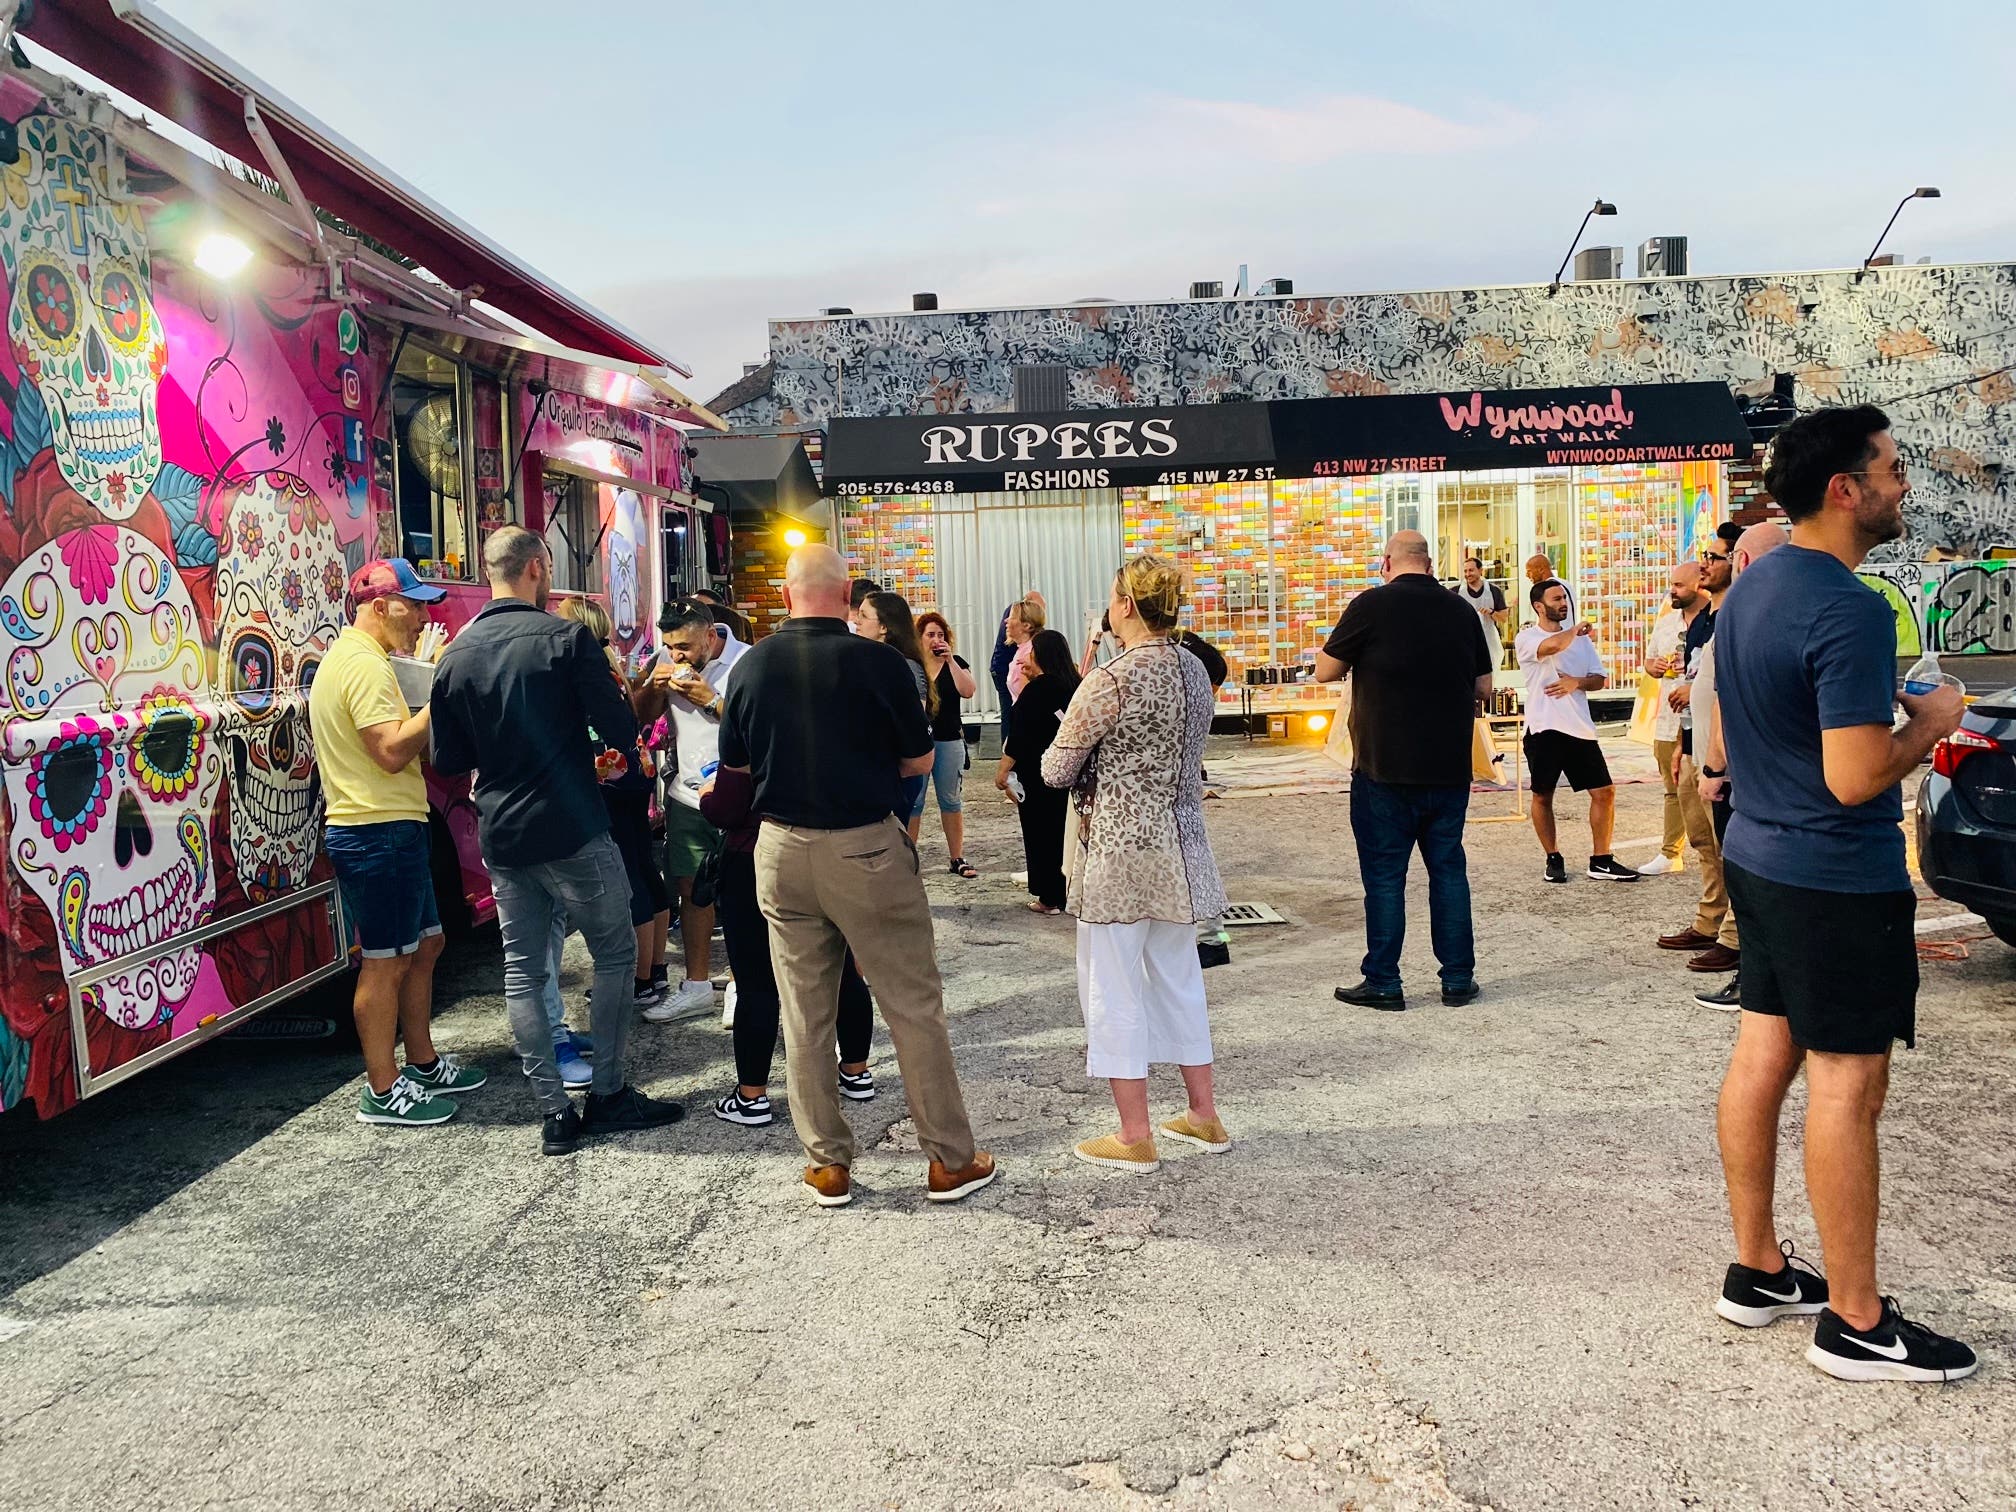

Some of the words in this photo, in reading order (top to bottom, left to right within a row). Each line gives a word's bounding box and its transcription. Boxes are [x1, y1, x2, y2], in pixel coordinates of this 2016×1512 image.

[1438, 387, 1634, 439] Wynwood
[921, 418, 1180, 465] RUPEES
[1508, 433, 1554, 446] ART
[1559, 429, 1621, 444] WALK
[1546, 443, 1734, 465] WYNWOODARTWALK.COM
[1157, 471, 1186, 485] 415
[1192, 470, 1219, 484] NW
[1227, 469, 1248, 482] 27
[1254, 468, 1277, 481] ST.
[1313, 460, 1340, 475] 413
[1343, 459, 1368, 474] NW
[1371, 458, 1389, 473] 27
[1391, 456, 1447, 472] STREET
[1003, 468, 1110, 491] FASHIONS
